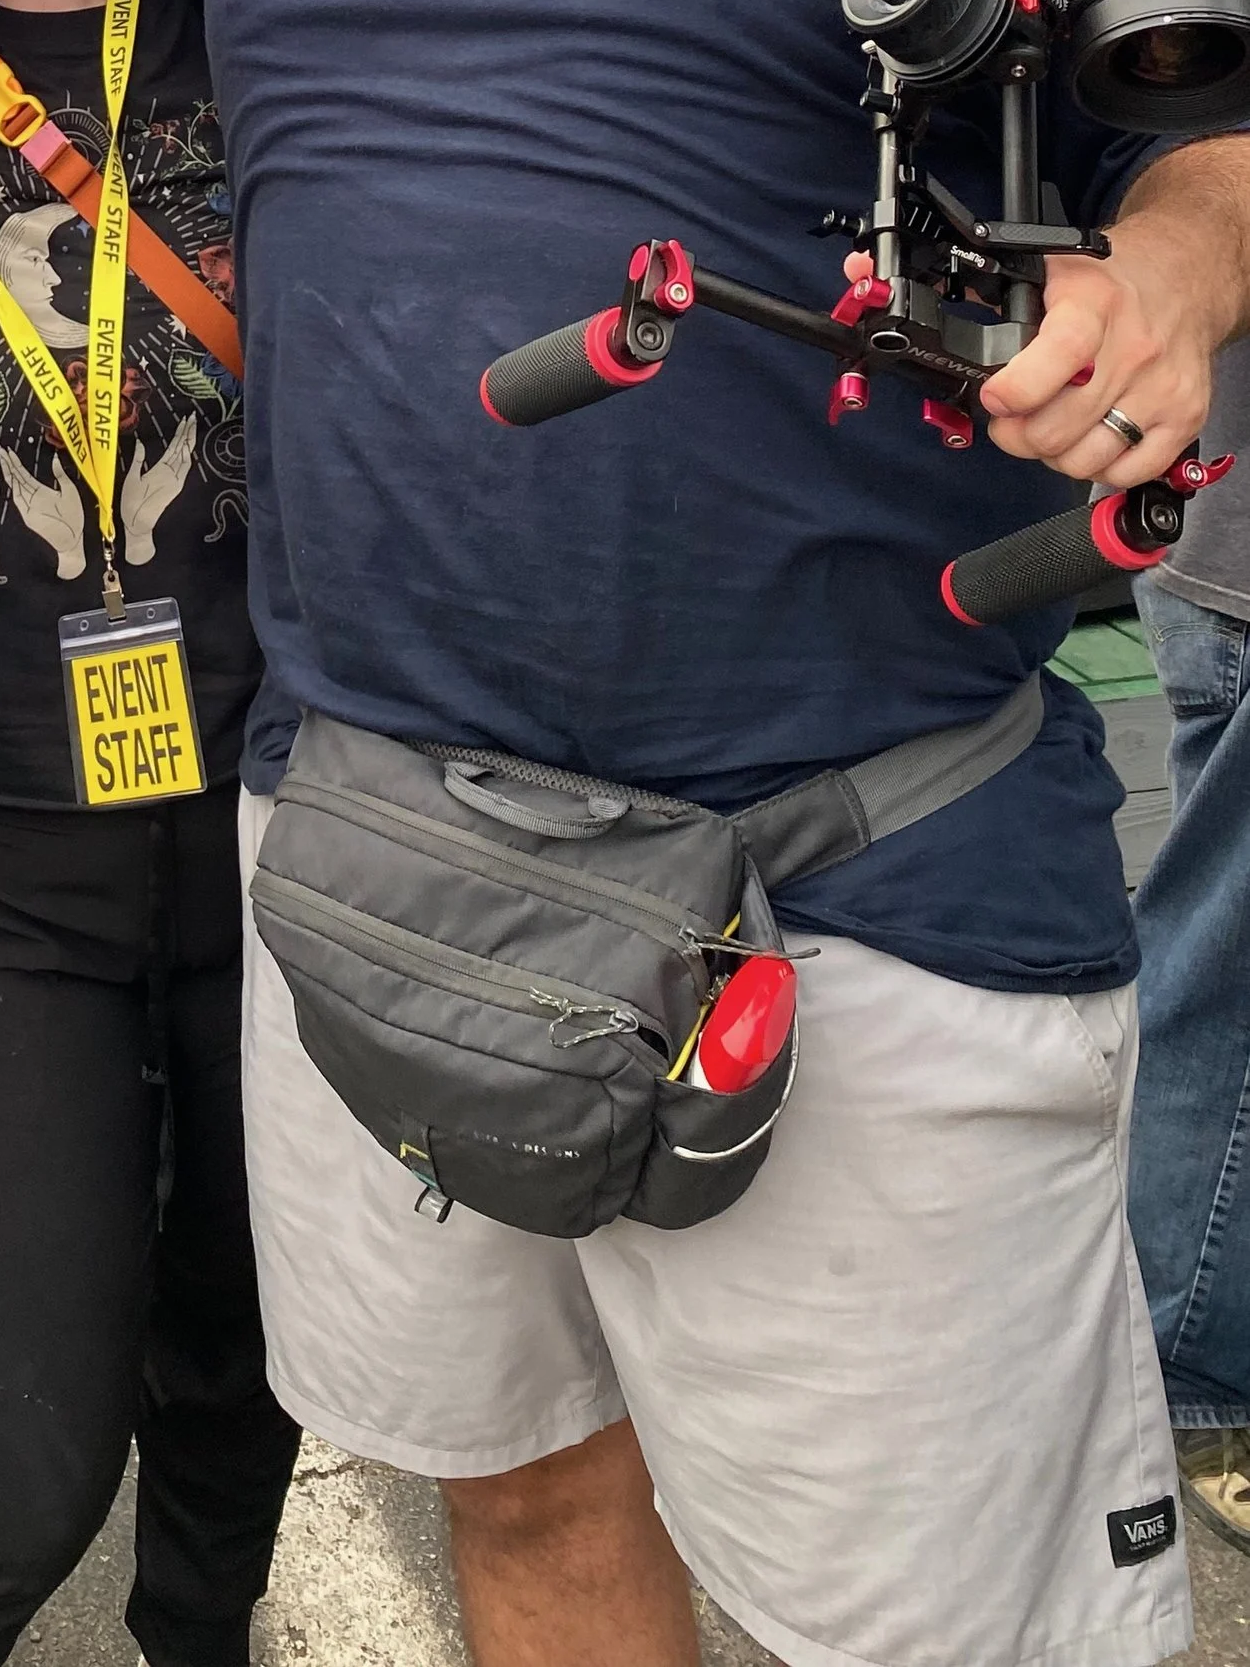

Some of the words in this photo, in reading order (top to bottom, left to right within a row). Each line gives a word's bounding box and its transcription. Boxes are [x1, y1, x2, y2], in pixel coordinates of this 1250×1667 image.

[109, 47, 126, 96] STAFF
[110, 151, 124, 200] VENT
[102, 204, 123, 264] STAFF
[20, 345, 63, 401] STAFF
[95, 317, 115, 383] EVENT
[55, 405, 88, 464] EVENT
[94, 389, 113, 451] STAFF
[84, 653, 171, 724] EVENT
[94, 722, 183, 793] STAFF
[523, 1143, 581, 1158] DESGNS
[1123, 1513, 1165, 1544] VANS
